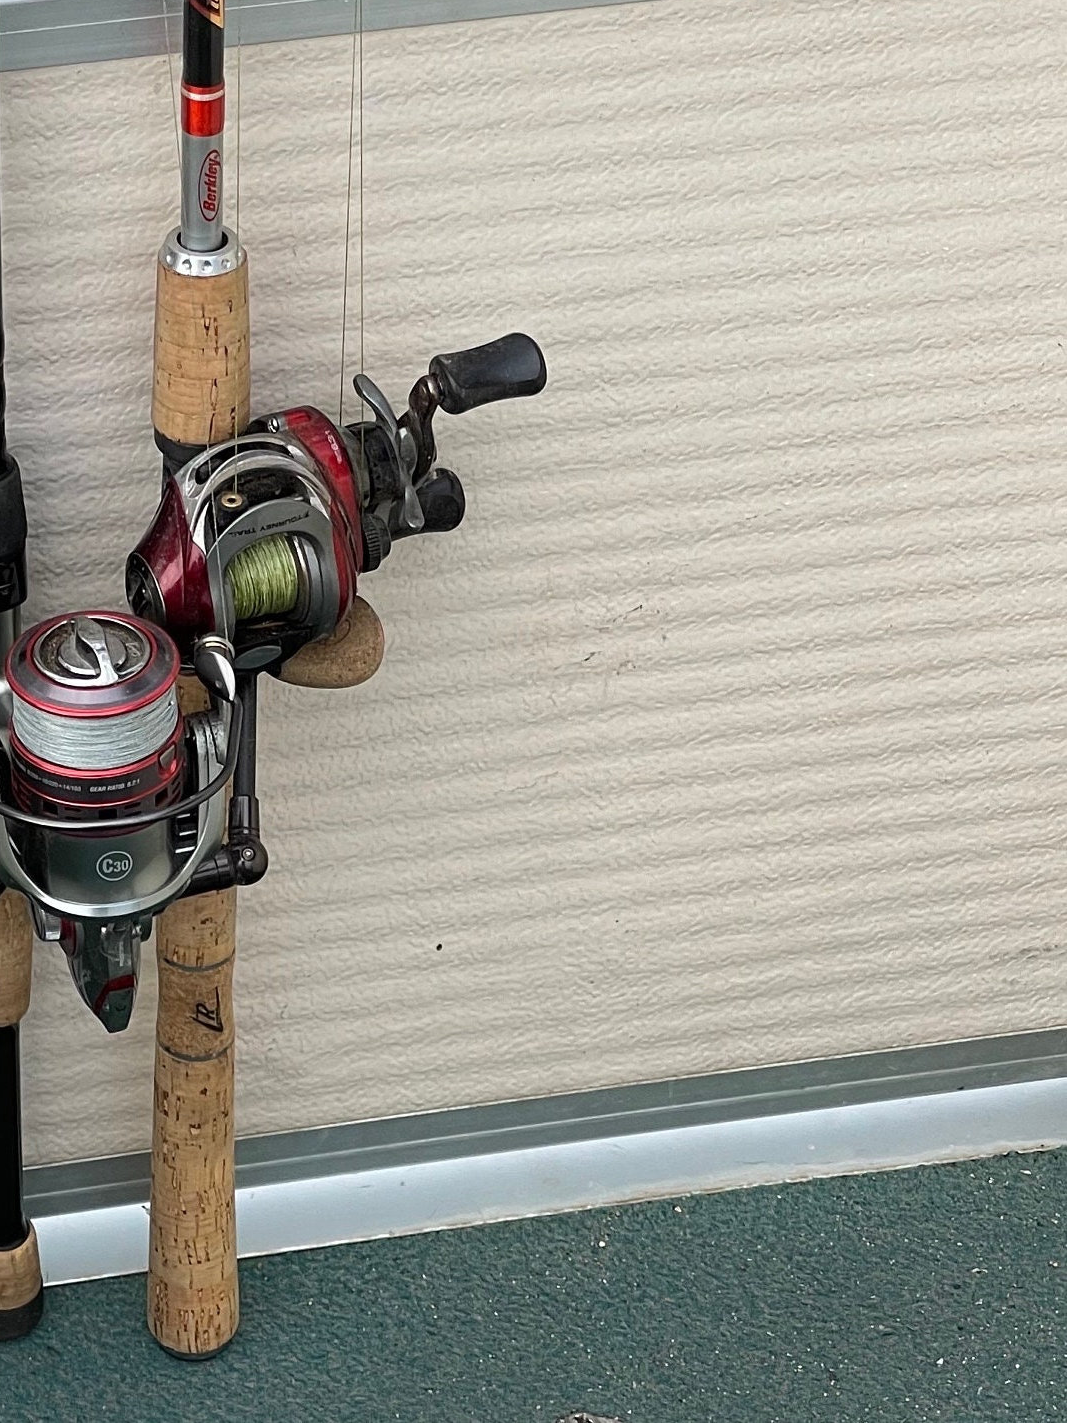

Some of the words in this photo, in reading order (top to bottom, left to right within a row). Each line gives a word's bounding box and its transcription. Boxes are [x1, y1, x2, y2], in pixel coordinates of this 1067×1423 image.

[202, 157, 221, 212] Berkley
[259, 514, 303, 532] TOURNEY
[89, 785, 107, 793] GEAR
[101, 857, 130, 874] C30
